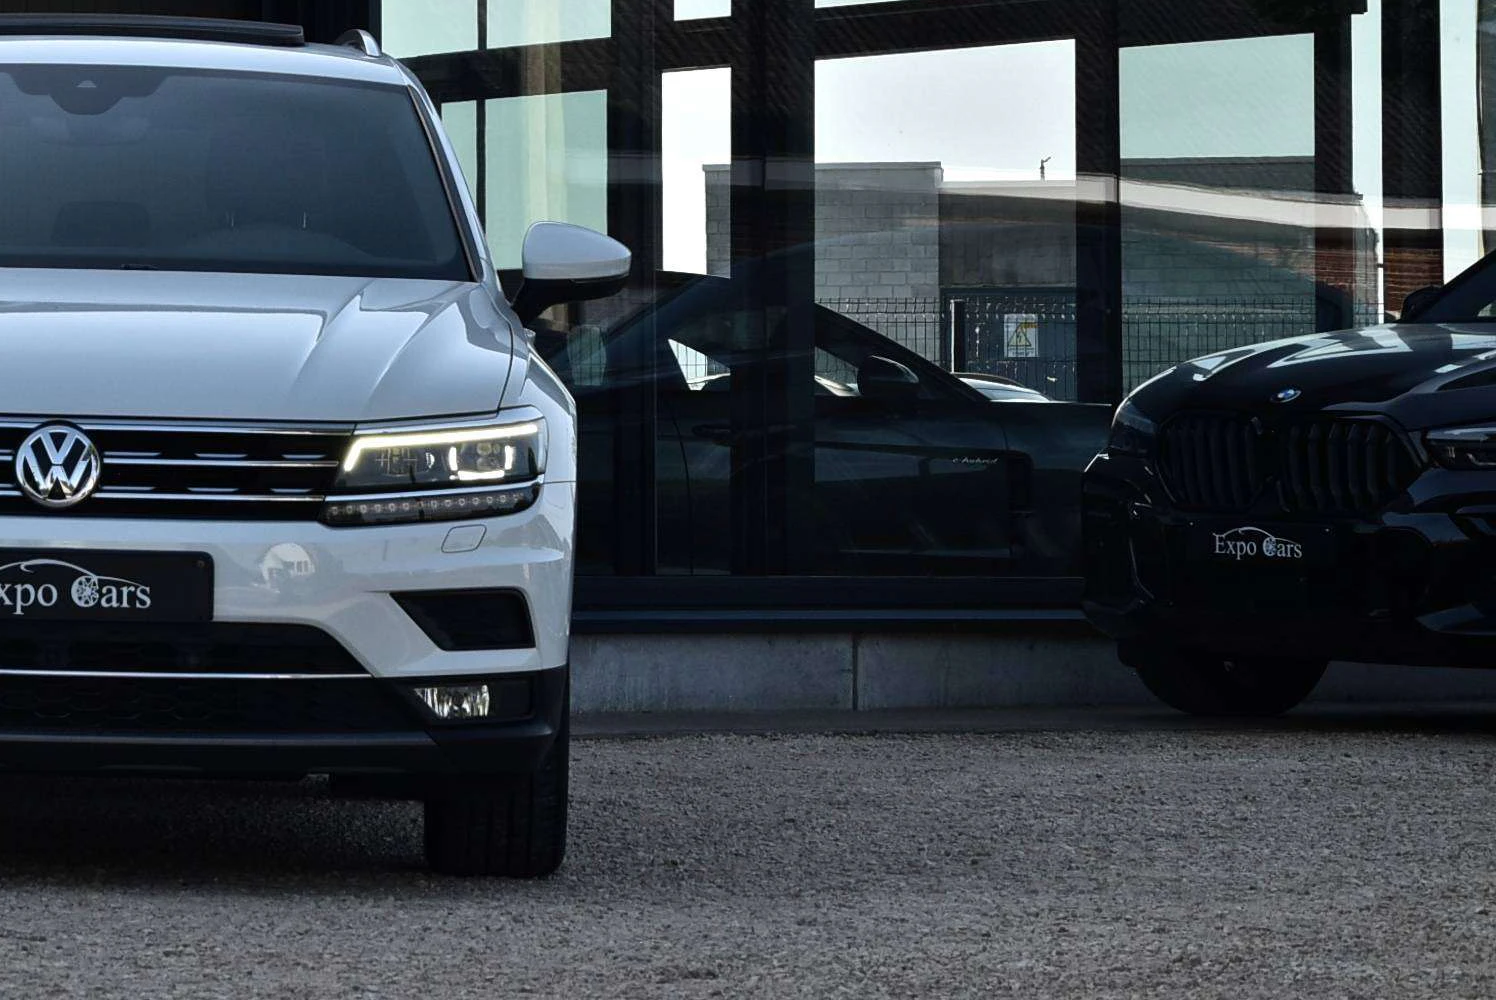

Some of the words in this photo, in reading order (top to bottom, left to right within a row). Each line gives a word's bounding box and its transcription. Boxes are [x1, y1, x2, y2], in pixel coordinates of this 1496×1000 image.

[1213, 533, 1257, 560] Expo
[1262, 536, 1302, 558] Cars
[71, 575, 151, 609] Cars
